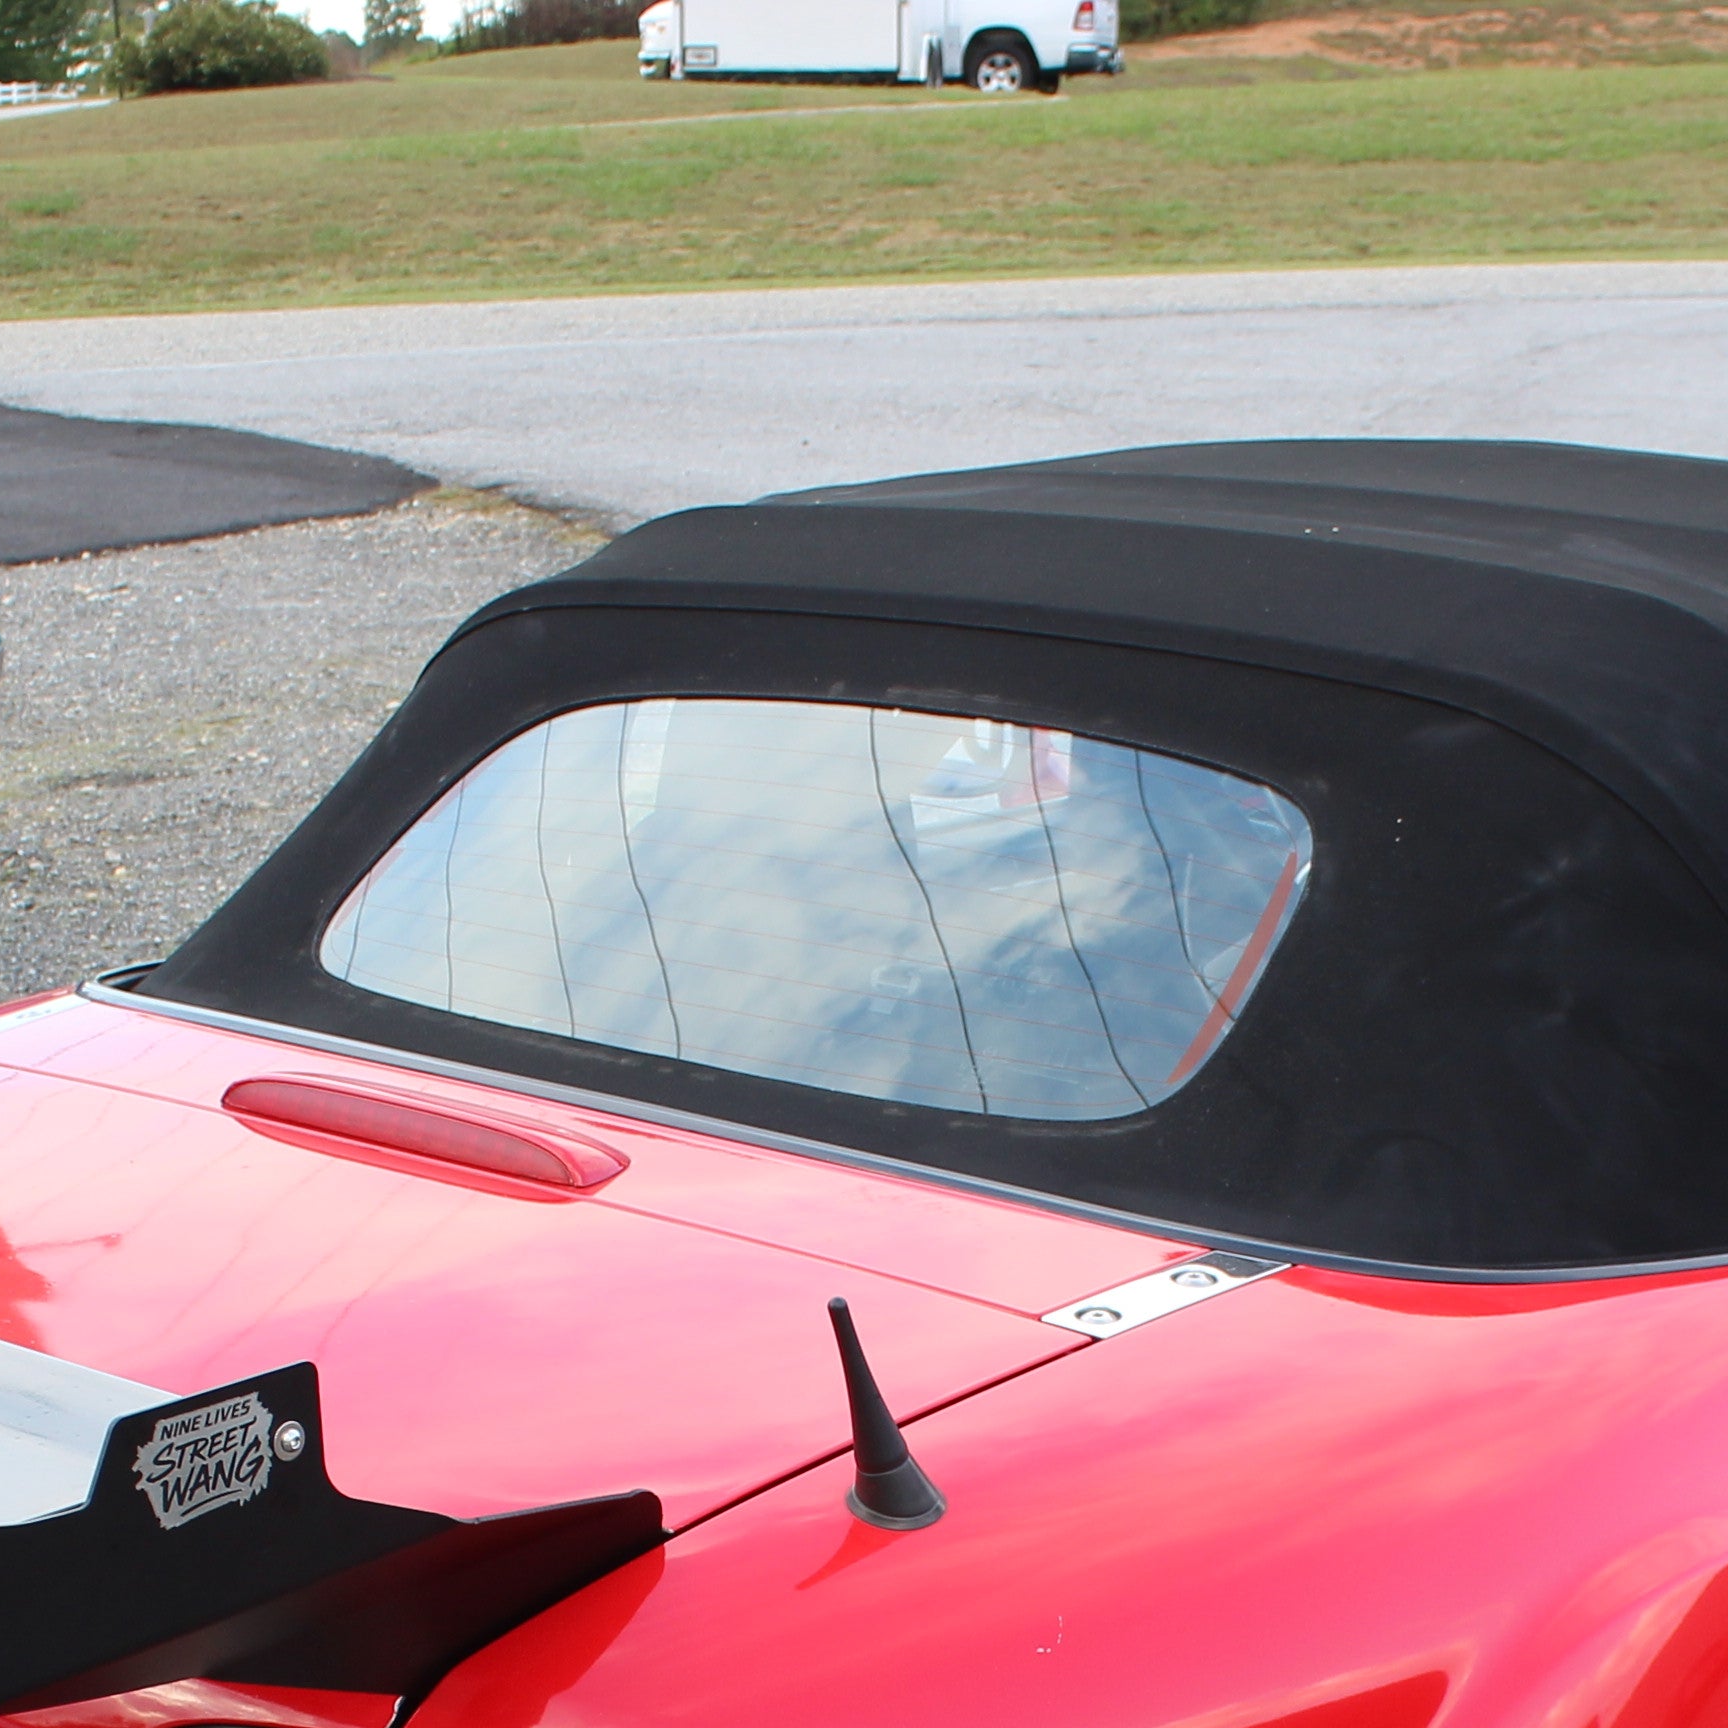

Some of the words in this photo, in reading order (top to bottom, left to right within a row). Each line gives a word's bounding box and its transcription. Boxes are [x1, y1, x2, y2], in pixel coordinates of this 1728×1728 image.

[145, 1415, 258, 1483] STREET
[160, 1418, 202, 1441] NINE
[205, 1399, 252, 1427] LIVES
[161, 1434, 266, 1513] WANG
